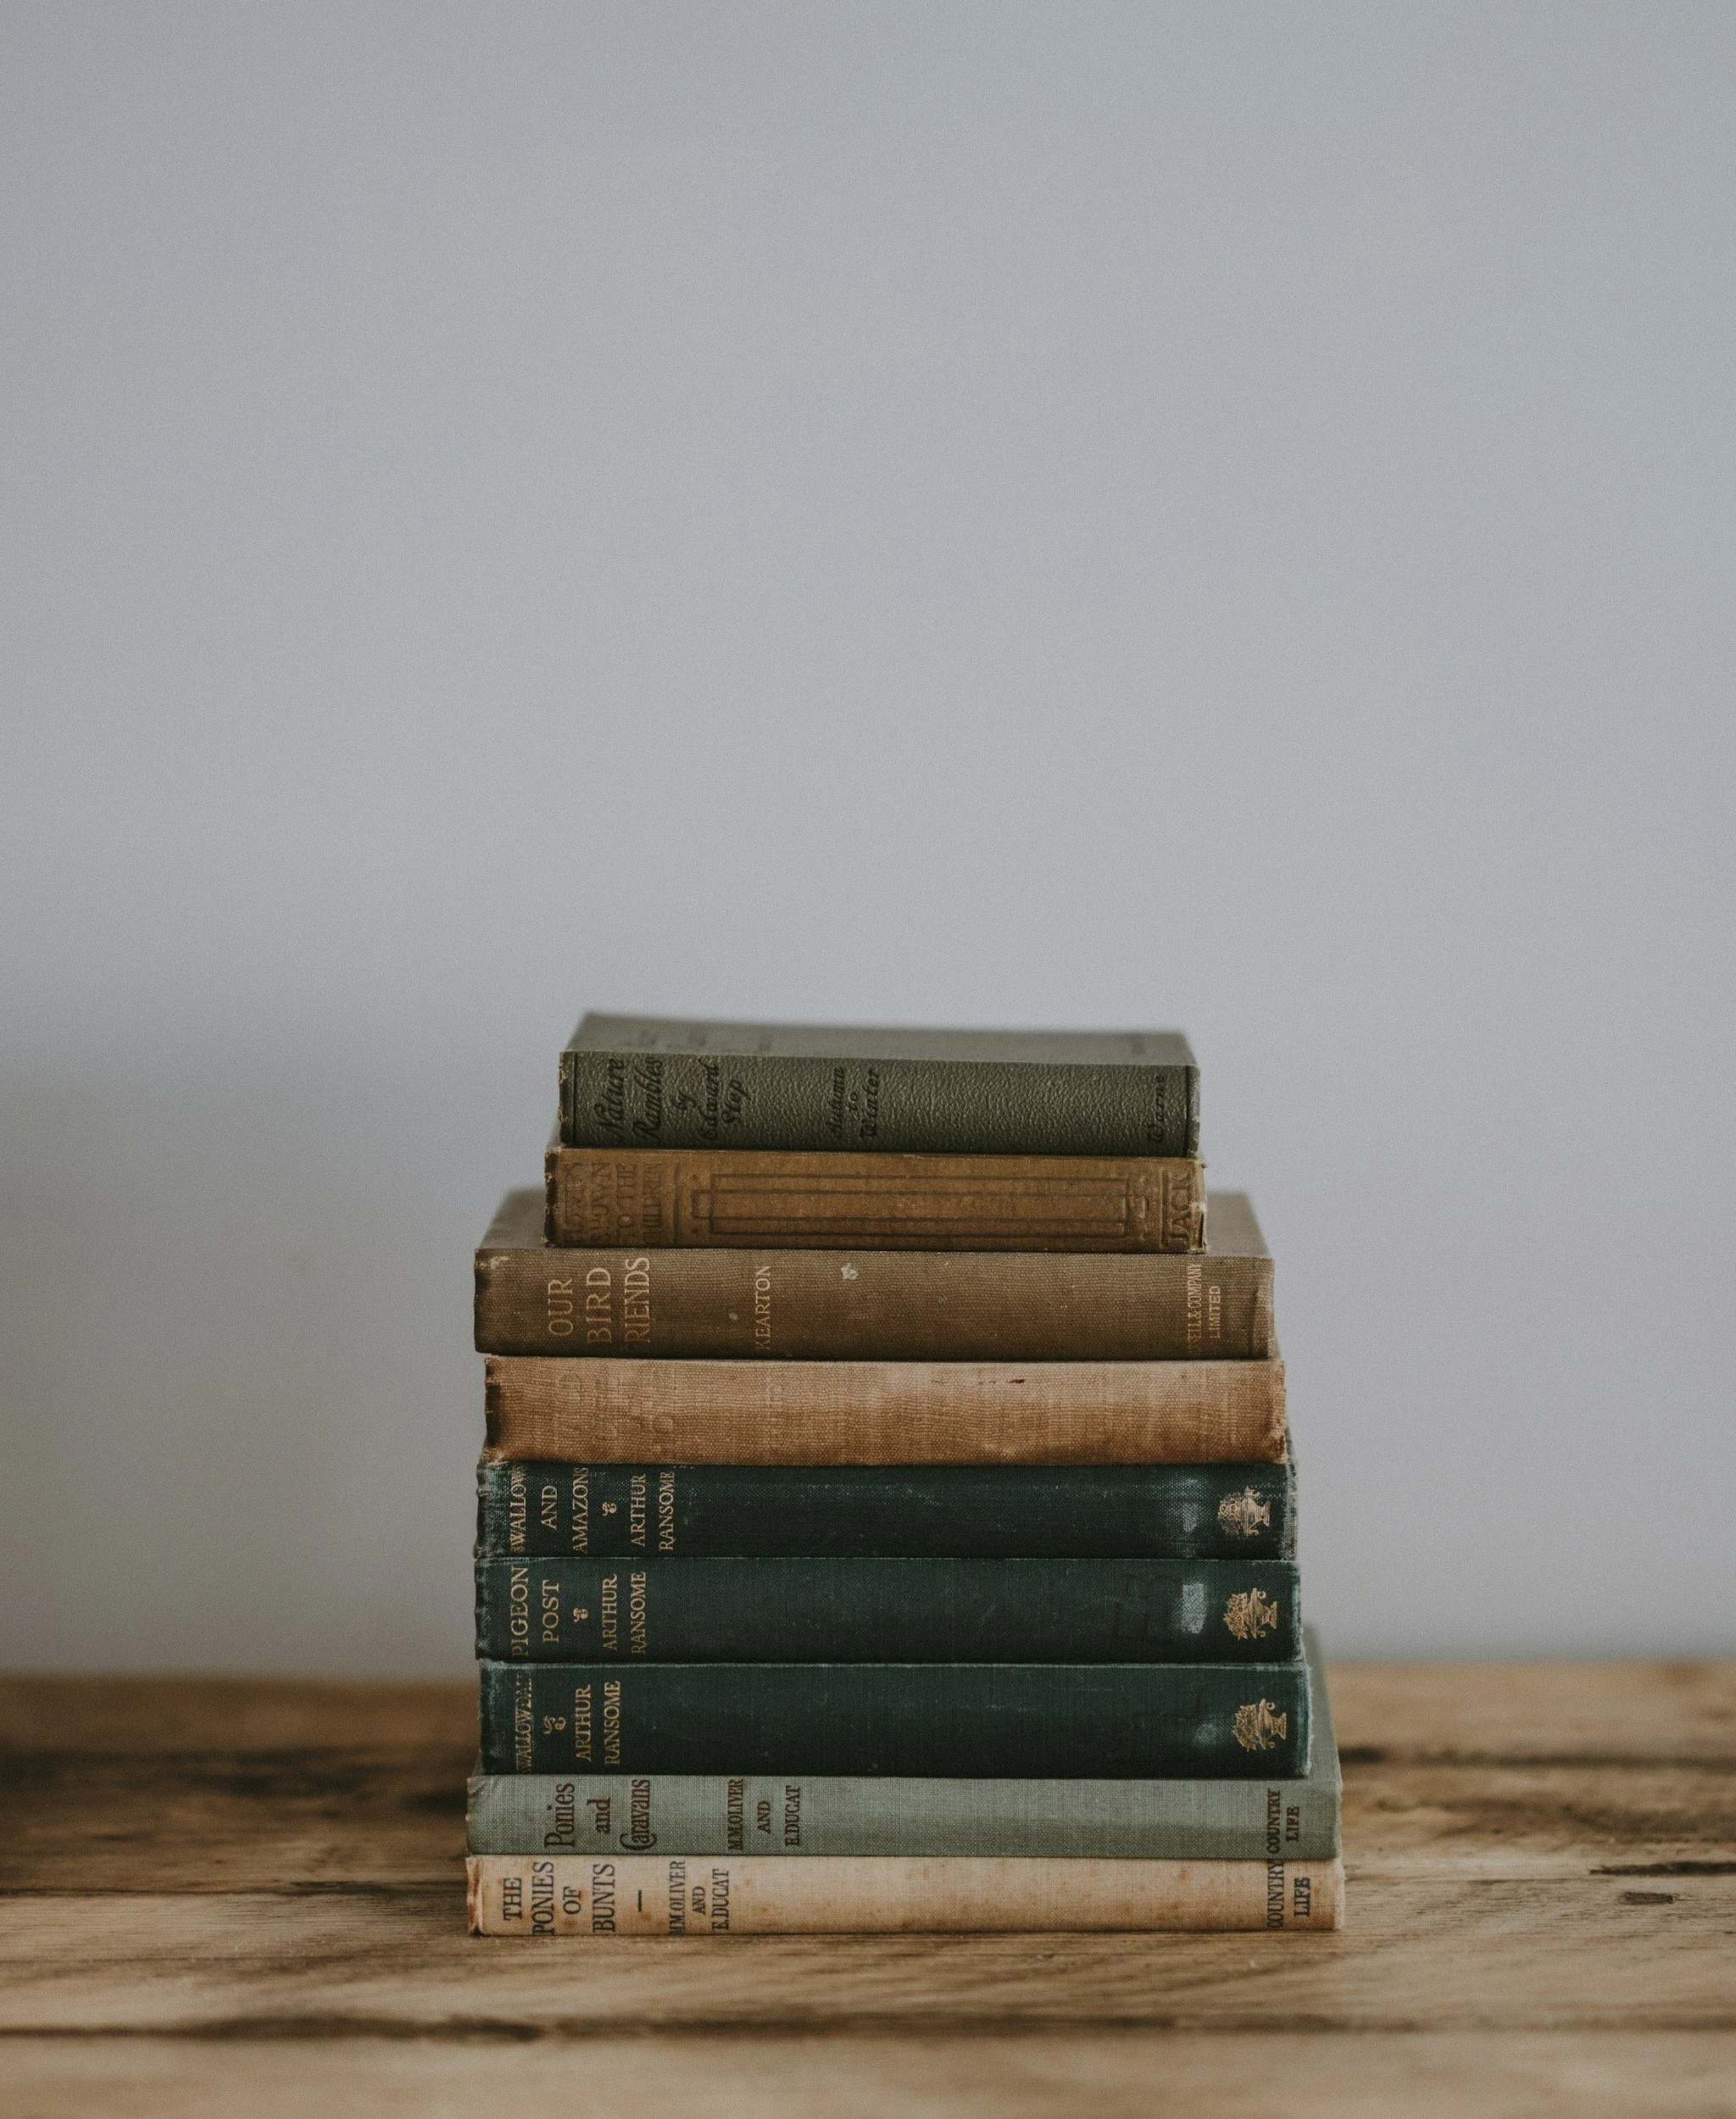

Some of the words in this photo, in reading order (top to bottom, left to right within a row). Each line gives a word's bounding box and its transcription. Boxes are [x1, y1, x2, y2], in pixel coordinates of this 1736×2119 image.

[593, 1057, 625, 1143] Nature
[632, 1055, 663, 1145] Rambles
[697, 1057, 720, 1141] Edward
[721, 1078, 750, 1125] Step
[548, 1277, 574, 1337] OUR
[585, 1266, 612, 1344] BIRD
[624, 1257, 651, 1345] RIENDS
[1187, 1263, 1202, 1309] COMPANY
[1209, 1285, 1221, 1339] LIMITED
[541, 1484, 558, 1531] AND
[571, 1467, 589, 1554] AMAZONS
[630, 1472, 647, 1548] ARTHUR
[659, 1471, 676, 1552] RANSOME
[509, 1565, 529, 1657] PIGEON
[542, 1579, 559, 1643] POST
[602, 1573, 618, 1651] ARTHUR
[630, 1571, 647, 1655] RANSOME
[576, 1683, 592, 1762] ARTHUR
[604, 1681, 621, 1766] RANSOME
[543, 1783, 576, 1849] Ponies
[586, 1796, 611, 1835] and
[620, 1778, 657, 1851] Caravans
[757, 1800, 771, 1834] AND
[1266, 1788, 1281, 1855] COUNTRY
[1286, 1805, 1299, 1842] LIFE
[503, 1877, 522, 1922] THE
[531, 1861, 554, 1935] PONIES
[562, 1886, 581, 1916] OF
[592, 1863, 615, 1933] BUNTS
[692, 1885, 706, 1916] AND
[1294, 1877, 1310, 1918] LIFE
